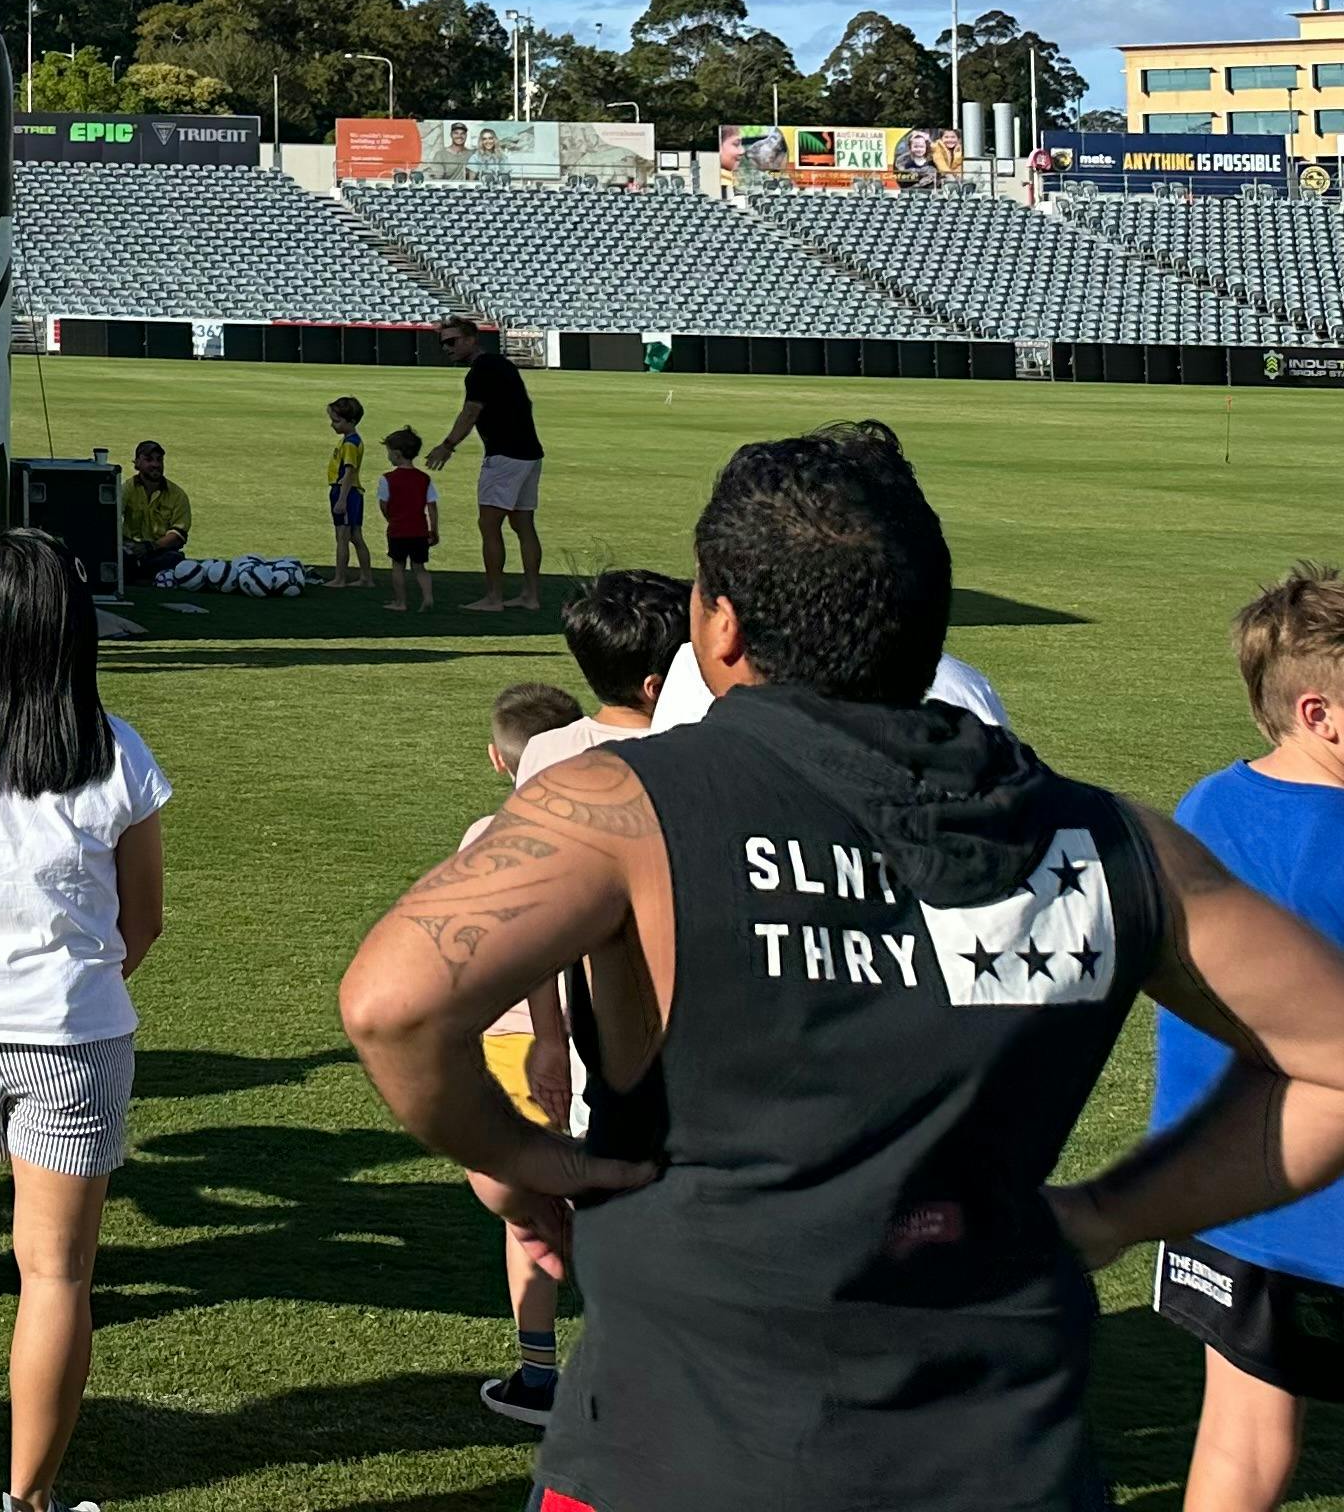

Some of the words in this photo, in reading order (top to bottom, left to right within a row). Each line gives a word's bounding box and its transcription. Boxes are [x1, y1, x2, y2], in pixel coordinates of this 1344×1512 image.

[69, 122, 134, 143] EPIC
[176, 127, 252, 143] TRIDENT
[836, 139, 884, 151] REPTILE
[836, 151, 884, 169] PARK
[1123, 152, 1195, 172] ANYTHING
[1197, 154, 1211, 172] IS
[1214, 154, 1282, 173] POSSIBLE
[754, 923, 918, 987] THRY
[1168, 1251, 1193, 1271] THE
